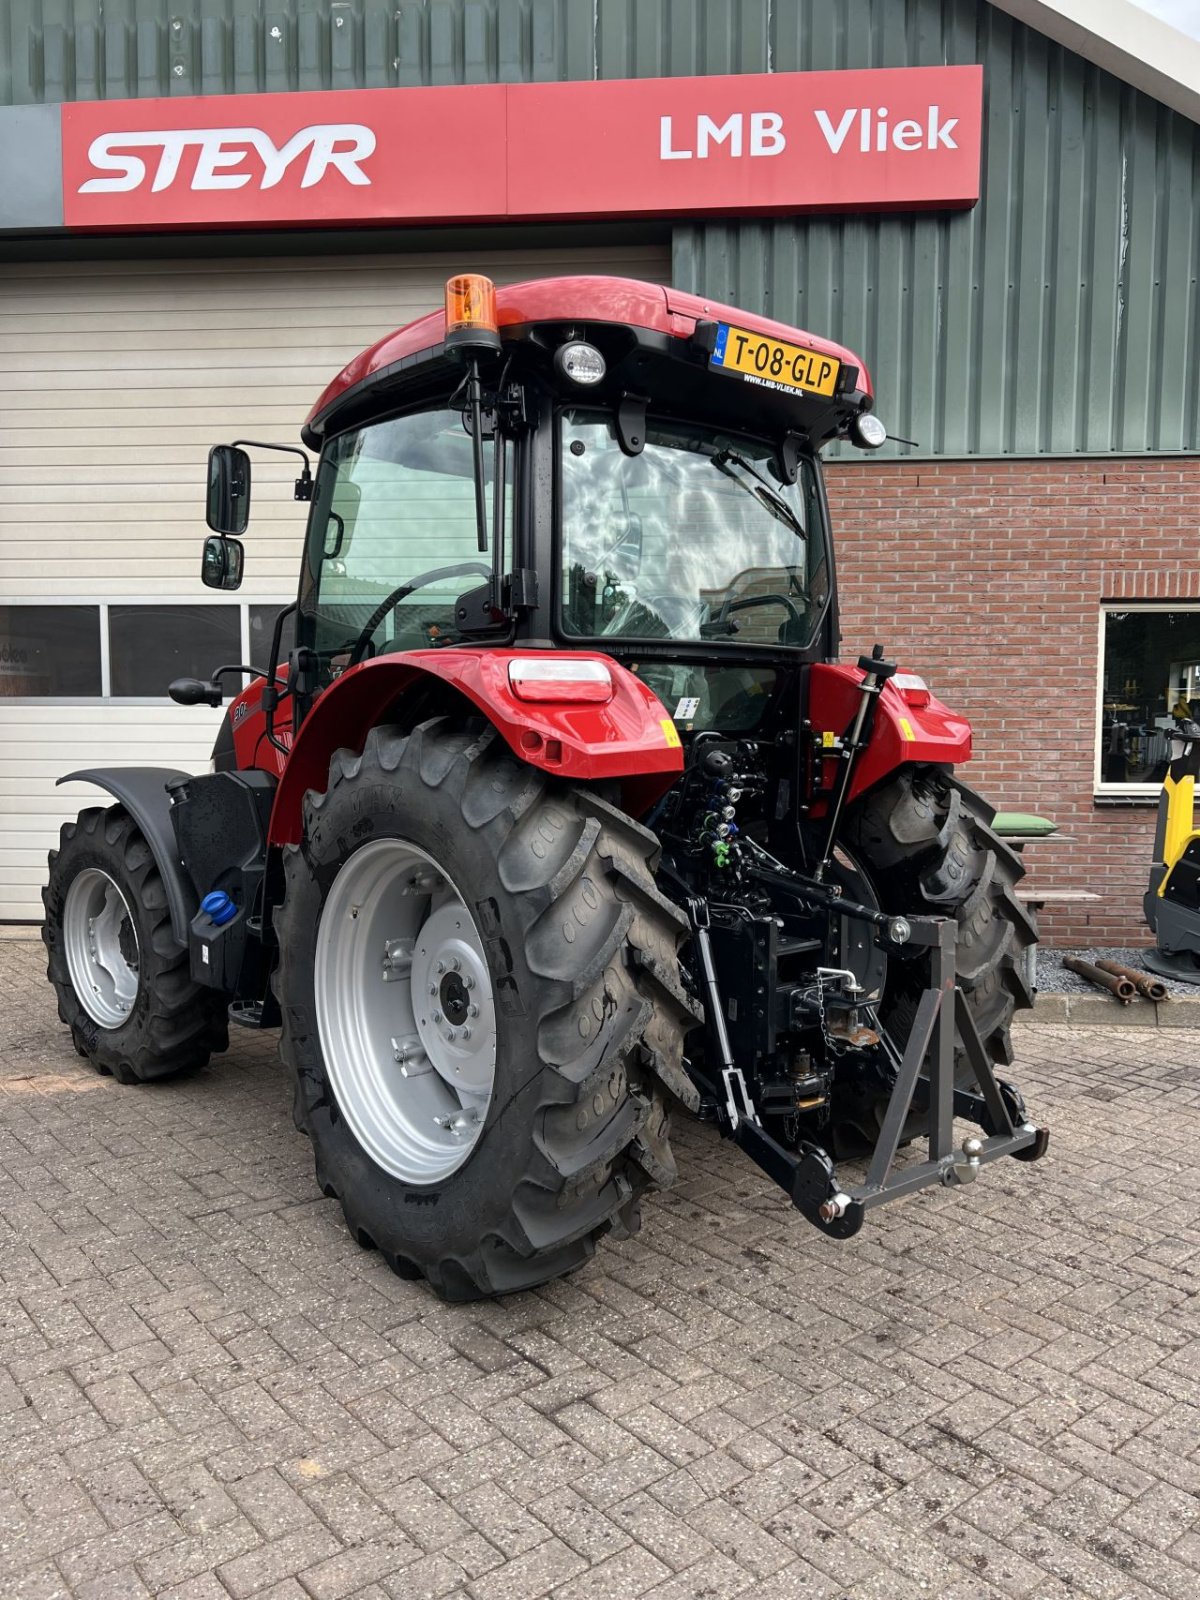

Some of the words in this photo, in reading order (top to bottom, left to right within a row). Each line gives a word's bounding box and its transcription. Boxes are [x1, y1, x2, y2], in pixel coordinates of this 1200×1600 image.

[77, 123, 377, 193] STEYR
[660, 111, 787, 160] LMB
[813, 104, 960, 155] Vliek
[713, 347, 723, 359] NL
[735, 335, 832, 388] T-08-GLP
